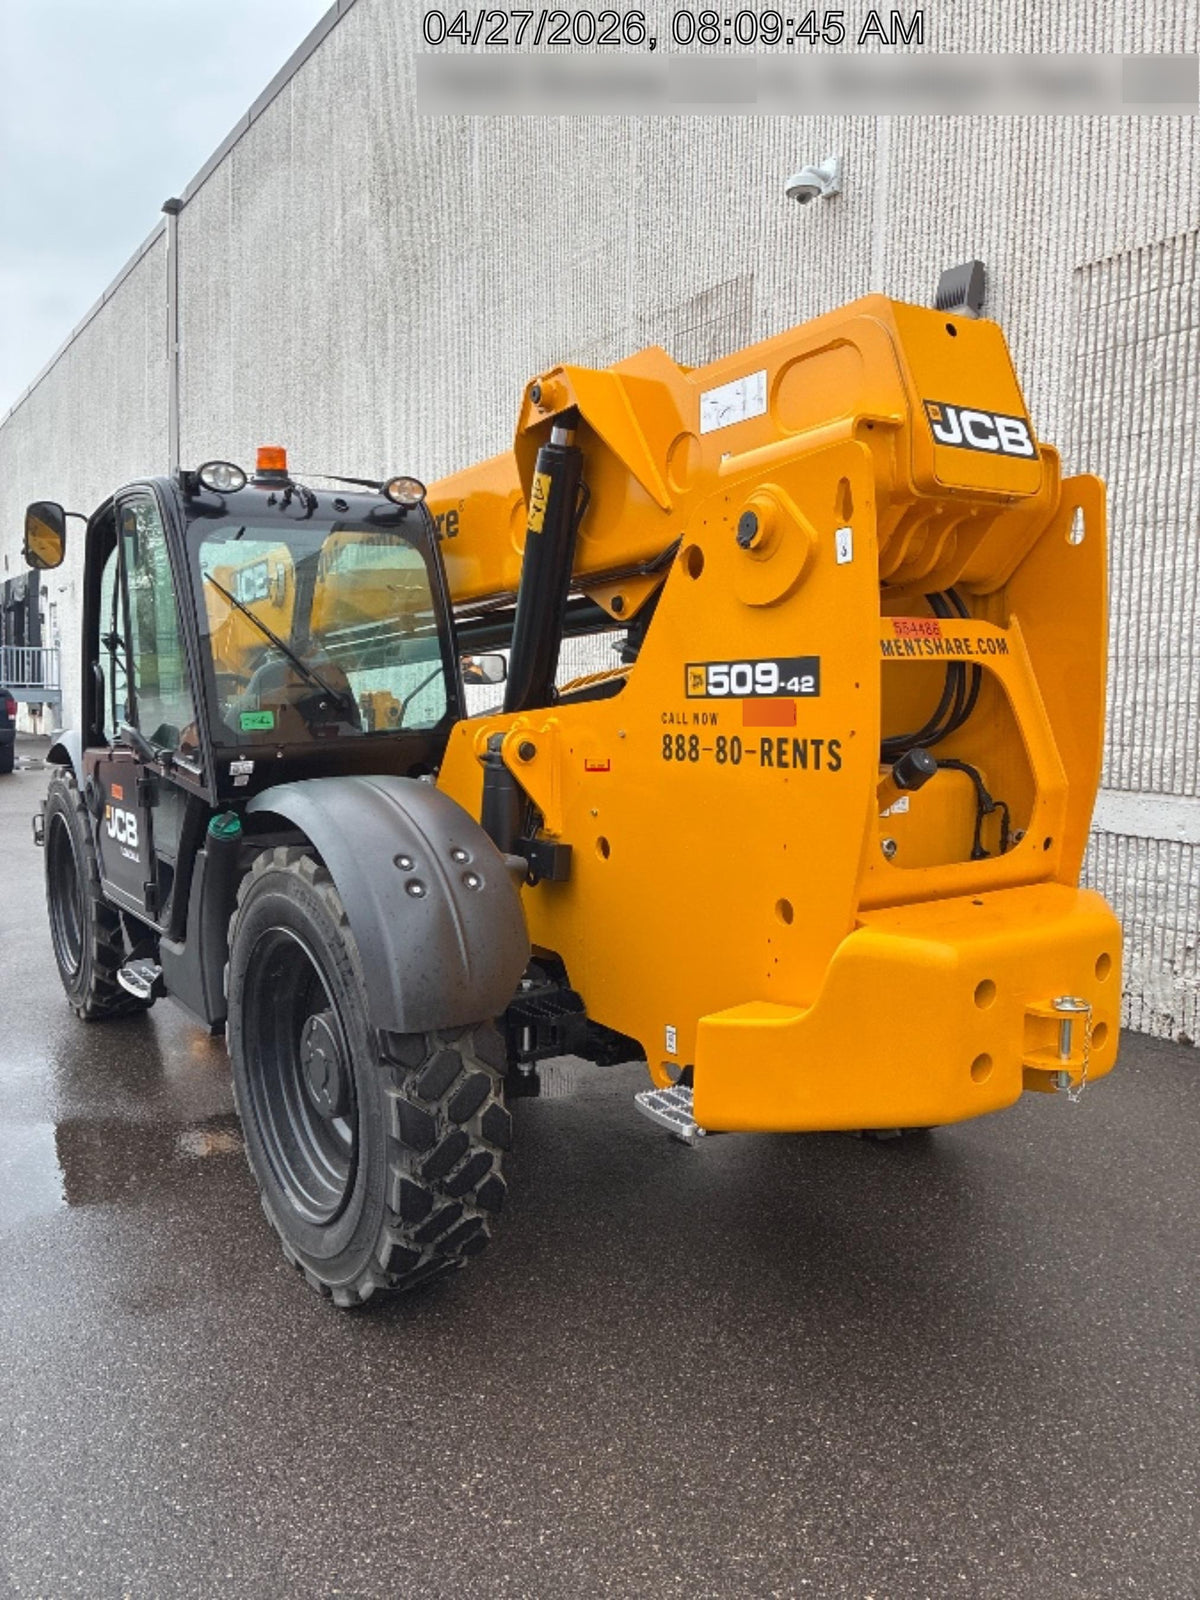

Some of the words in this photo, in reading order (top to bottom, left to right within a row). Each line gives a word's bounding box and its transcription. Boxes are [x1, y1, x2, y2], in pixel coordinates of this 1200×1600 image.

[932, 406, 1034, 456] JCB
[880, 637, 1009, 656] MENTSHARE.COM
[661, 712, 688, 725] CALL
[693, 713, 719, 726] NOW
[662, 733, 842, 772] 888-80-RENTS
[106, 806, 139, 847] JCB
